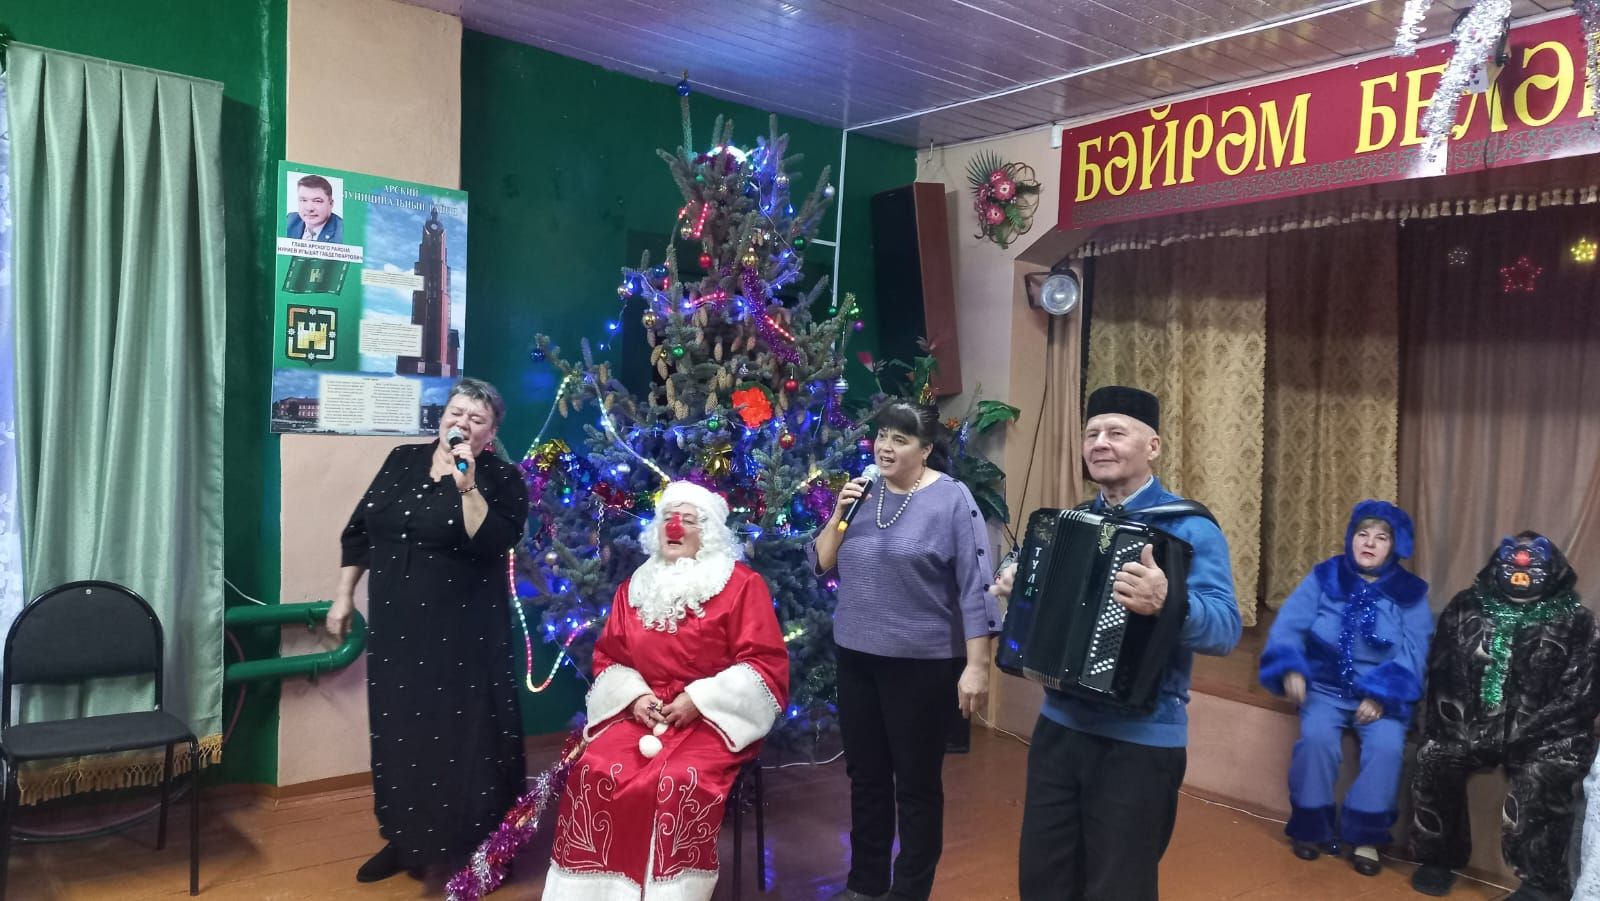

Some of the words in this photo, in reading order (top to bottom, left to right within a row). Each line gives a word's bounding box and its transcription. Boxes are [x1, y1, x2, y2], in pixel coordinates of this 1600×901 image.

[1074, 92, 1312, 203] БӘЙРӘМ
[383, 184, 419, 198] АРСКИЙ
[1024, 546, 1043, 597] ТУЛА
